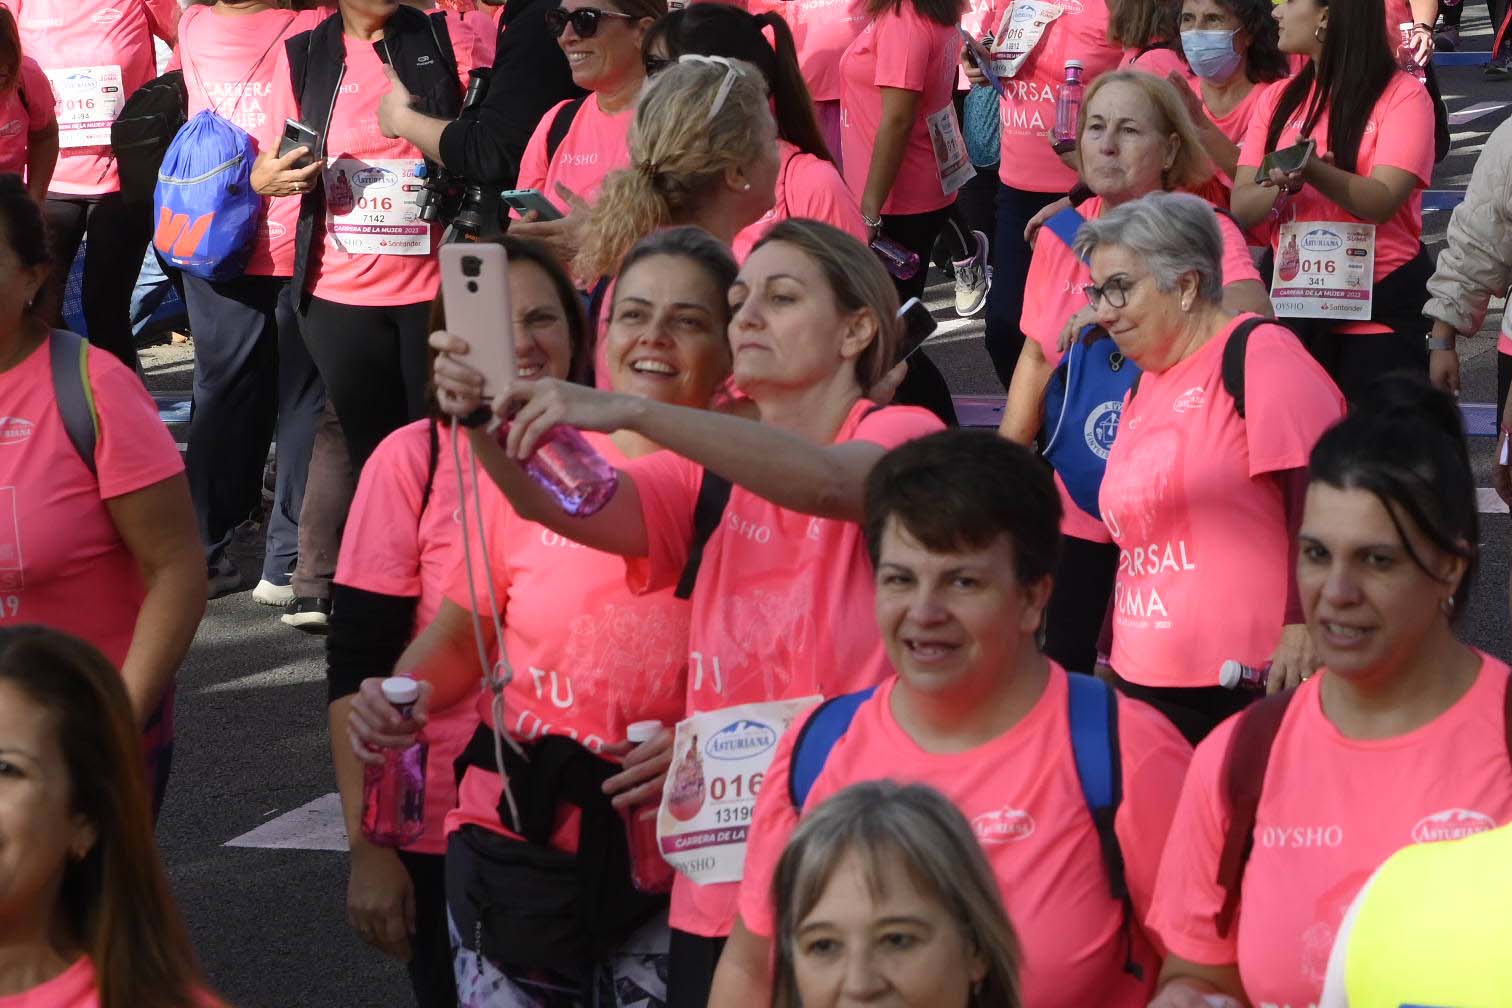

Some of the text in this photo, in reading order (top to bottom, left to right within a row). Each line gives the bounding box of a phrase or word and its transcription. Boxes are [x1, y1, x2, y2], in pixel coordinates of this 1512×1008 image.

[1007, 28, 1024, 39] 016
[358, 197, 392, 210] 016
[363, 215, 385, 223] 7142
[1302, 260, 1336, 273] 016
[1309, 278, 1325, 286] 341
[1275, 302, 1363, 312] OYSHO Santander
[528, 665, 575, 709] TU
[713, 736, 769, 752] ASTURIANA
[710, 772, 764, 801] 016
[675, 829, 745, 848] CARRERA DE LA
[1261, 825, 1343, 848] OYSHO
